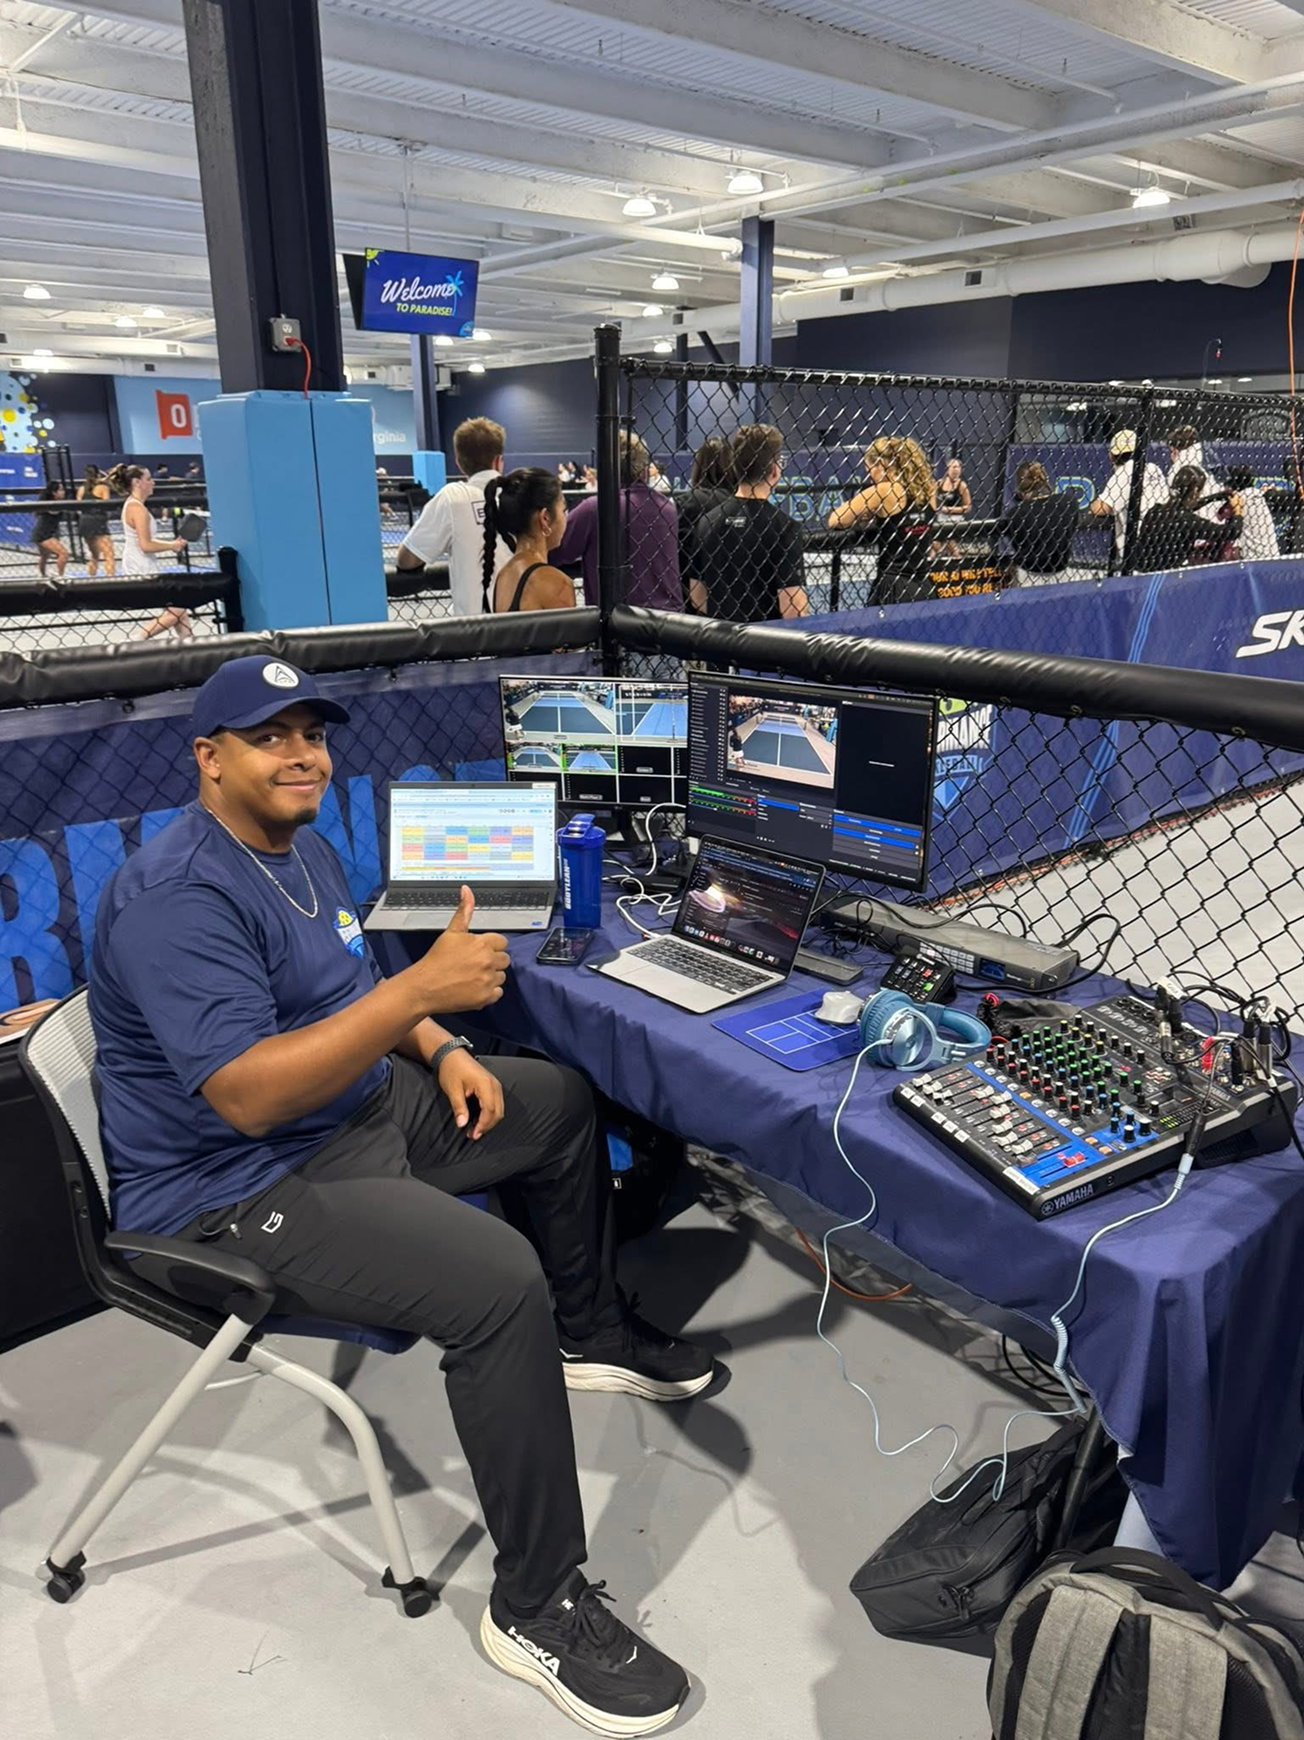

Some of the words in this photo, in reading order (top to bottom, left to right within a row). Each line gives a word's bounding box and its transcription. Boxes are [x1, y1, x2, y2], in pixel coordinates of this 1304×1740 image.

[381, 276, 457, 303] Welcome
[396, 303, 409, 313] TO
[410, 304, 453, 317] PARADISE!
[1053, 1183, 1094, 1210] YAMAHA
[507, 1625, 561, 1676] HOKA
